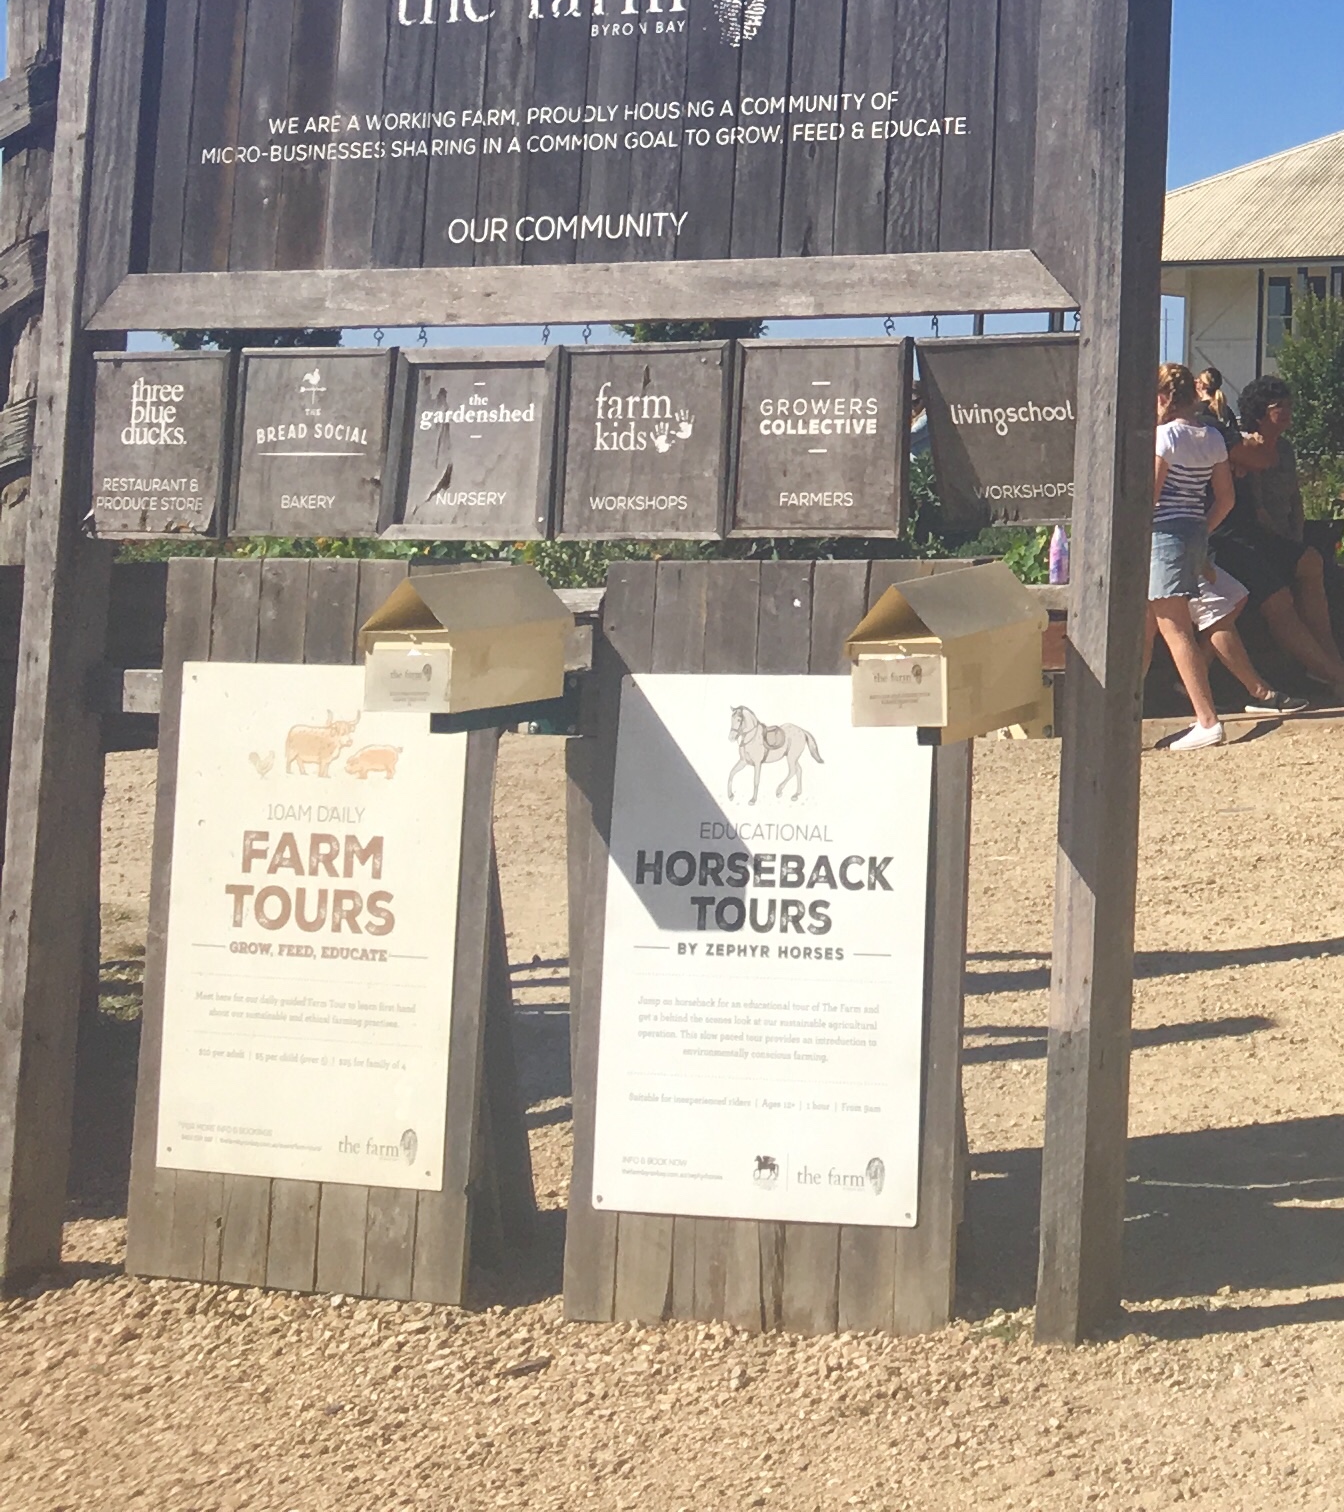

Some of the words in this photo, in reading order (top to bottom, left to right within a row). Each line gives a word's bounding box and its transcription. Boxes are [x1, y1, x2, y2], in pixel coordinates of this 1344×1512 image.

[591, 22, 648, 37] BYRON
[655, 20, 686, 34] BAY
[268, 117, 299, 135] WE
[304, 115, 342, 134] ARE
[347, 114, 361, 131] A
[365, 110, 456, 131] WORKING
[461, 108, 520, 128] FARM,
[527, 104, 619, 125] PROUDLY
[719, 99, 734, 117] A
[741, 93, 866, 115] COMMUNITY
[870, 91, 899, 110] OF
[201, 140, 386, 164] MICRO-BUSINESSES
[390, 137, 476, 158] SHARING
[483, 137, 502, 154] IN
[507, 136, 522, 154] A
[526, 132, 618, 153] COMMON
[624, 129, 679, 150] GOAL
[685, 128, 711, 147] TO
[715, 124, 785, 145] GROW,
[792, 122, 846, 142] FEED
[851, 122, 865, 140] &
[448, 217, 508, 244] OUR
[515, 211, 689, 242] COMMUNITY
[131, 377, 184, 402] three
[468, 394, 489, 406] the
[595, 381, 673, 419] farm
[760, 398, 878, 416] GROWERS
[130, 399, 177, 424] blue
[420, 403, 536, 430] gardenshed
[950, 400, 1075, 436] livingschool
[120, 420, 187, 445] ducks.
[256, 423, 307, 445] BREAD
[314, 423, 368, 445] SOCIAL
[593, 422, 648, 451] kids
[759, 418, 878, 435] COLLECTIVE
[102, 478, 187, 493] RESTAURANT
[189, 478, 199, 493] &
[973, 483, 1075, 500] WORKSHOPS
[96, 496, 157, 511] PRODUCE
[160, 496, 203, 511] STORE
[281, 494, 336, 509] BAKERY
[436, 491, 507, 506] NURSERY
[590, 495, 688, 510] WORKSHOPS
[779, 491, 854, 507] FARMERS
[267, 804, 312, 822] 10AM
[317, 805, 366, 823] DAILY
[699, 822, 834, 842] EDUCATIONAL
[242, 830, 384, 880] FARM
[635, 849, 895, 892] HORSEBACK
[225, 884, 396, 936] TOURS
[690, 896, 833, 935] TOURS
[229, 941, 274, 957] GROW,
[278, 943, 317, 960] FEED,
[320, 946, 388, 962] EDUCATE
[677, 942, 698, 955] BY
[705, 943, 771, 958] ZEPHYR
[778, 945, 845, 960] HORSES
[638, 995, 661, 1008] Jump
[674, 997, 716, 1007] horseback
[717, 997, 729, 1008] for
[731, 1001, 741, 1009] an
[743, 999, 790, 1011] educational
[792, 1002, 810, 1011] tour
[811, 1001, 820, 1011] of
[822, 1002, 838, 1012] The
[840, 1003, 861, 1013] Farm
[863, 1004, 880, 1014] and
[638, 1013, 651, 1023] get
[660, 1012, 688, 1023] behind
[690, 1013, 704, 1023] the
[705, 1017, 732, 1025] scenes
[734, 1014, 752, 1025] look
[753, 1017, 762, 1026] at
[763, 1018, 777, 1026] our
[779, 1018, 827, 1029] sustainable
[828, 1019, 878, 1031] agricultural
[680, 1029, 698, 1040] This
[700, 1030, 718, 1040] slow
[720, 1031, 744, 1042] paced
[746, 1034, 763, 1043] tour
[765, 1033, 800, 1044] provides
[802, 1036, 813, 1045] an
[815, 1035, 866, 1047] introduction
[868, 1038, 877, 1047] to
[751, 1050, 791, 1060] conscious
[661, 1092, 672, 1103] for
[761, 1098, 781, 1110] Ages
[812, 1100, 830, 1110] hour
[841, 1102, 862, 1112] From
[338, 1135, 361, 1154] the
[366, 1136, 399, 1157] farm
[797, 1165, 822, 1185] the
[828, 1166, 865, 1187] farm
